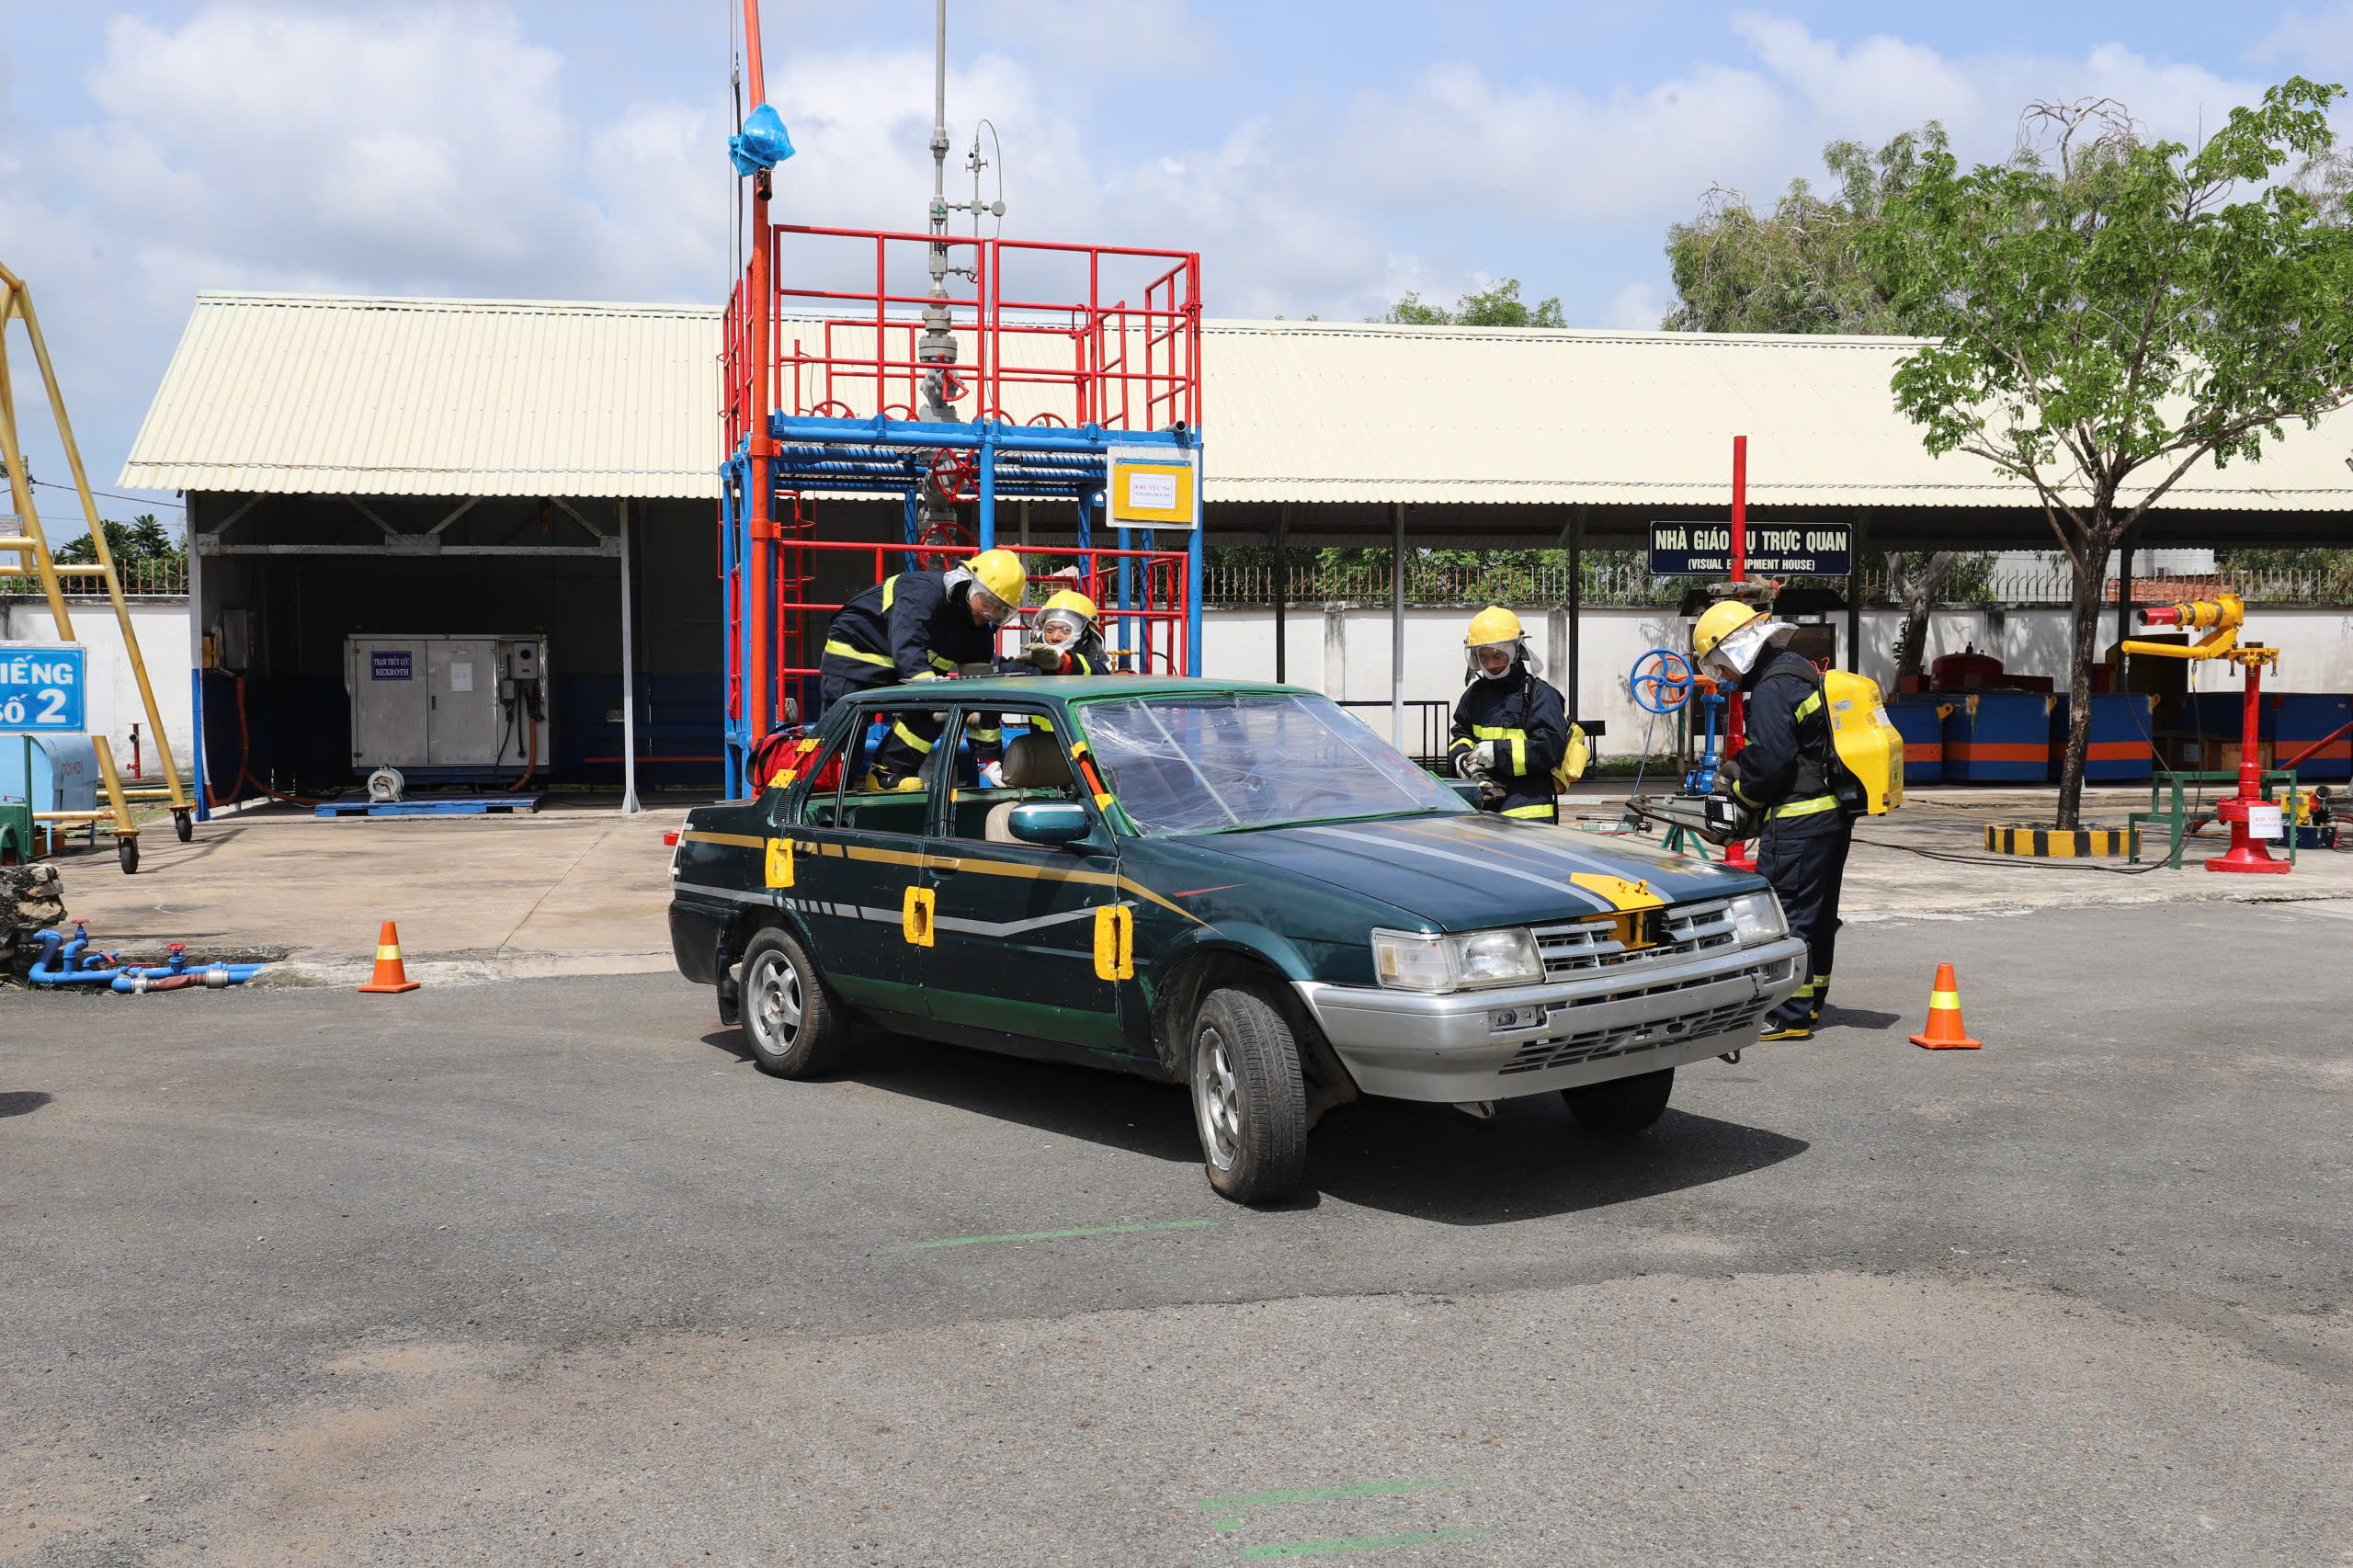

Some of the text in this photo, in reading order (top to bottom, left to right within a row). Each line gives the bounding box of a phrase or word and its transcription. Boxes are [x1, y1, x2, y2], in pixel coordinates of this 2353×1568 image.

[1655, 526, 1688, 551] NHÀ
[1693, 526, 1730, 551] GIÁO
[1761, 528, 1802, 555] TRỰC
[1805, 530, 1847, 553] QUAN
[1688, 558, 1815, 572] (VISUAL EIPMENT HOUSE)
[375, 668, 409, 676] REXROTH
[0, 687, 67, 723] Ố 2
